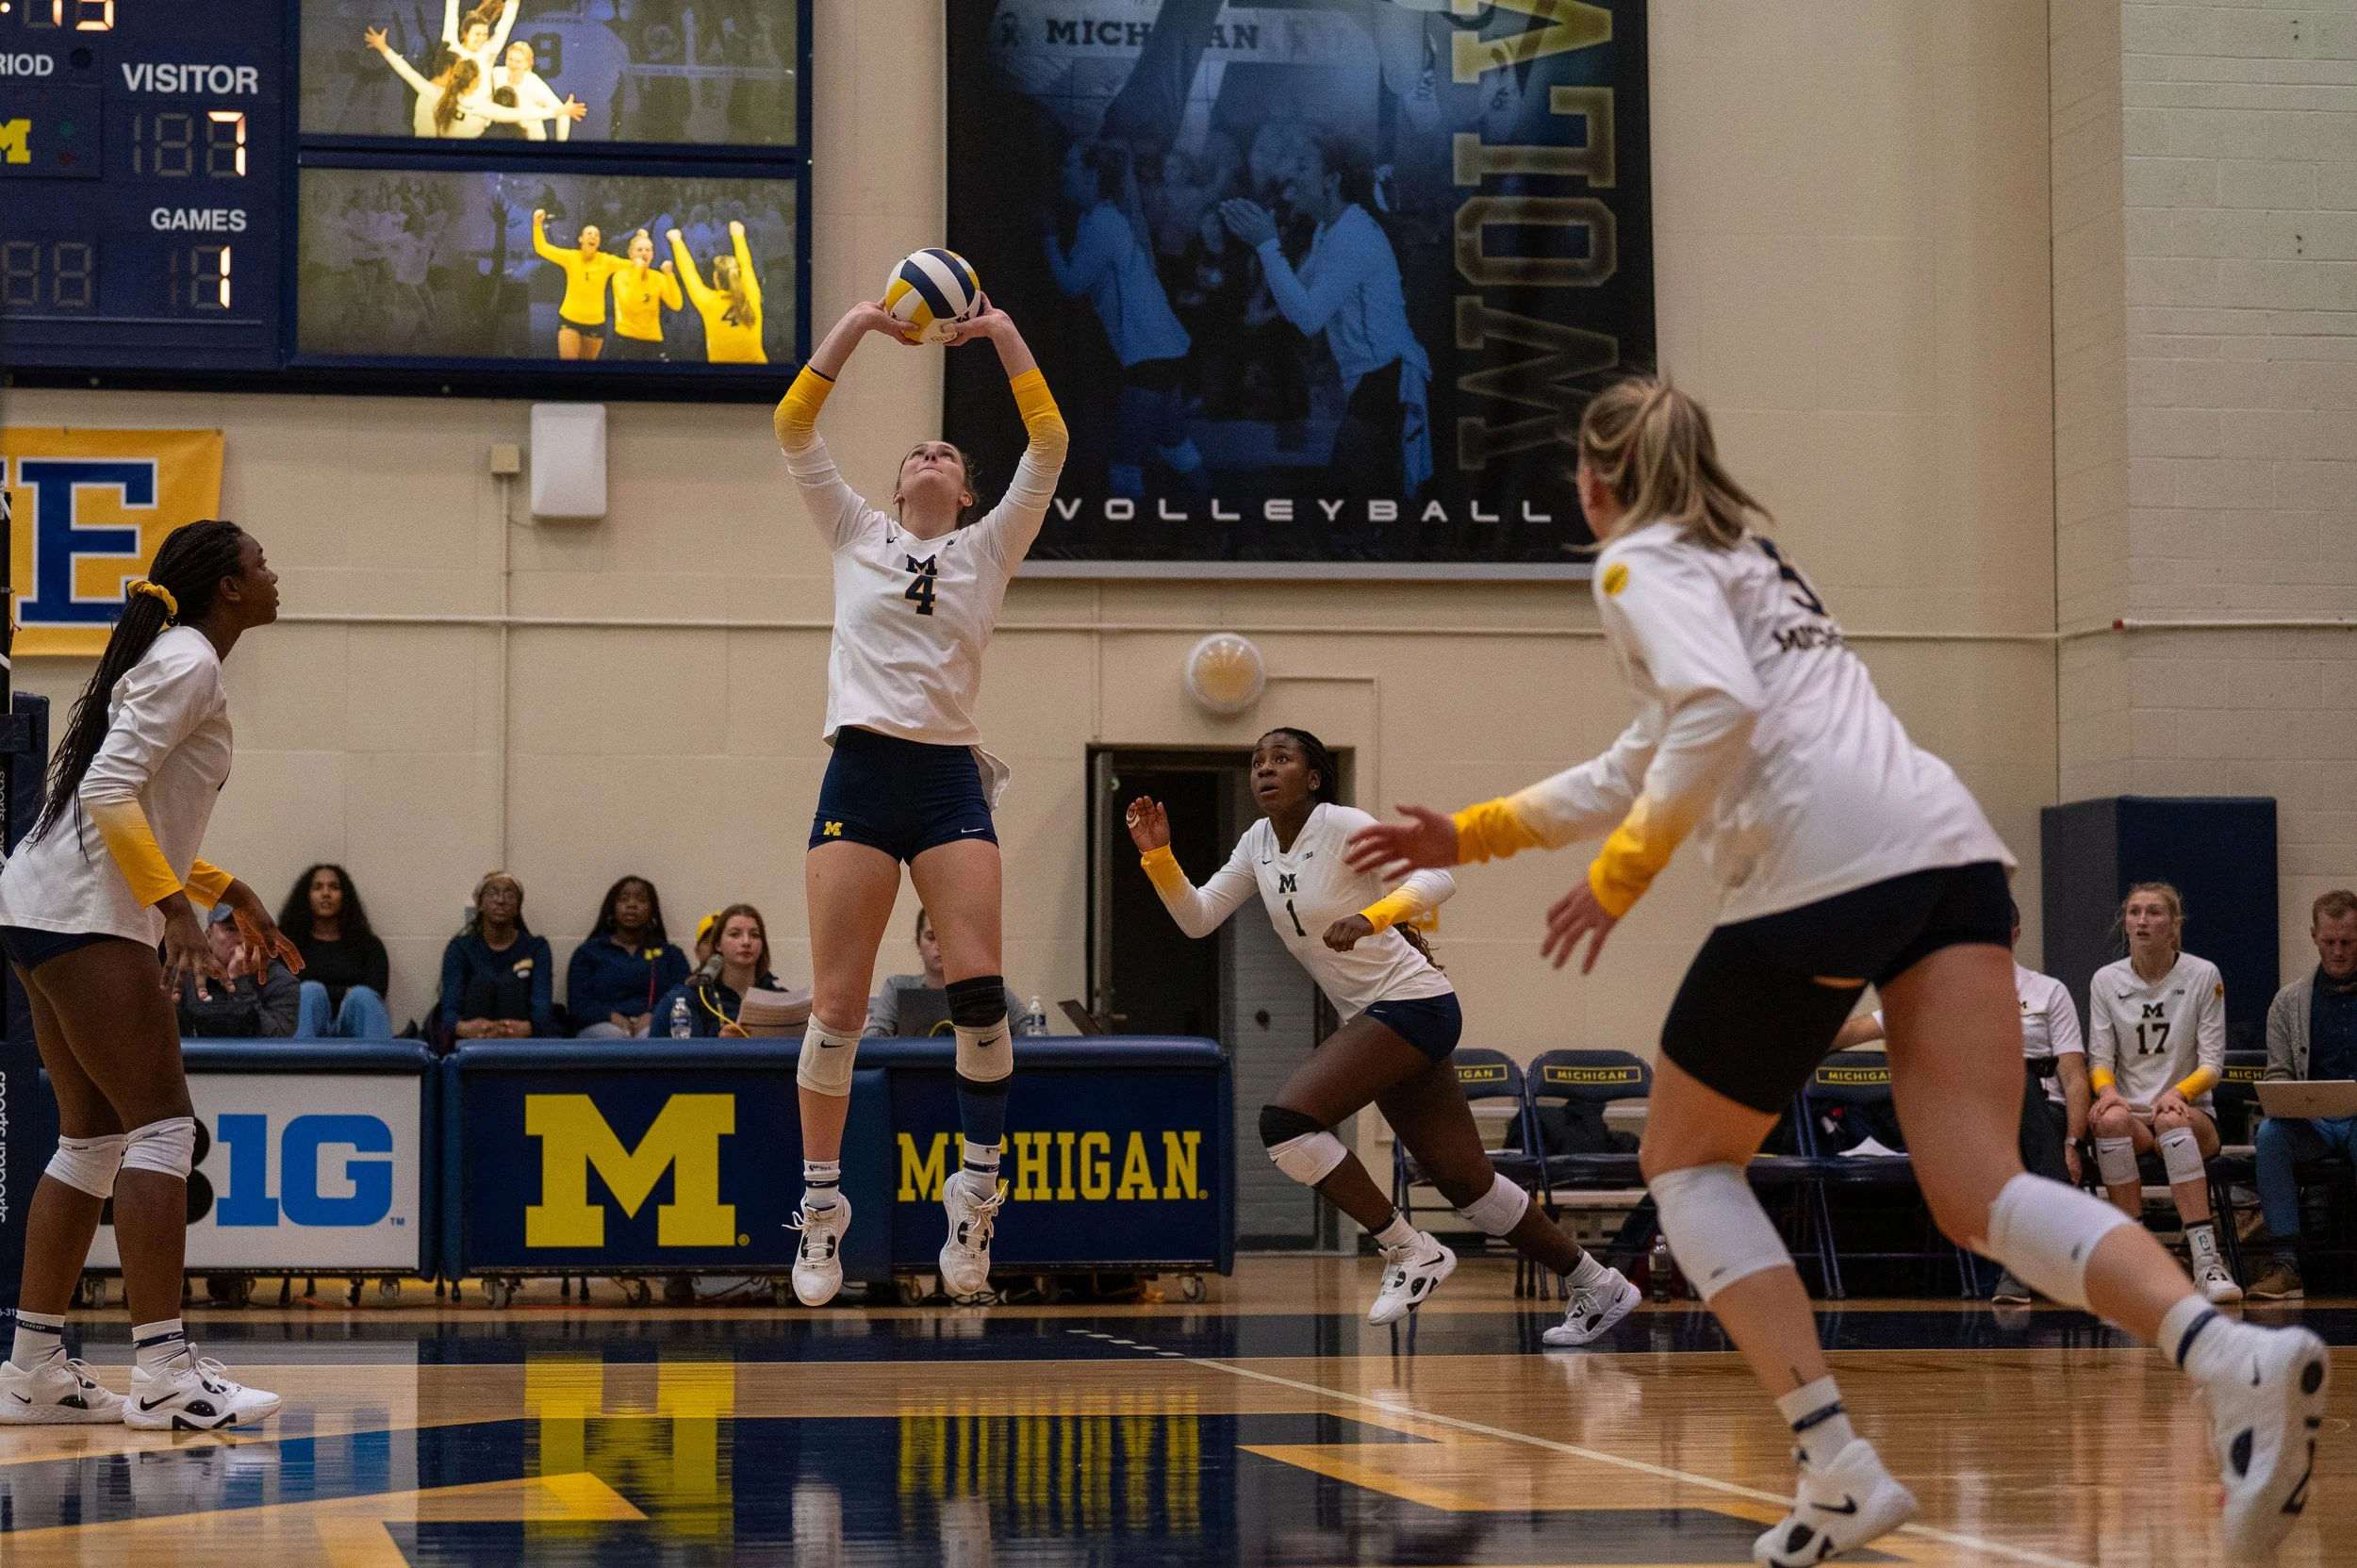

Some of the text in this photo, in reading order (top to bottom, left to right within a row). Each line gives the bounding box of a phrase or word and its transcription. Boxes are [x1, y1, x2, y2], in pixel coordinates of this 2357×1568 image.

[1046, 19, 1259, 48] MICHAN
[122, 63, 258, 94] VISITOR
[206, 110, 247, 177] 7
[150, 207, 247, 232] GAMES
[219, 245, 231, 309] 1
[1055, 498, 1552, 522] VOLLEYBALL
[905, 553, 938, 576] M
[904, 574, 937, 617] 4
[823, 821, 843, 836] M
[1278, 873, 1298, 894] M
[1286, 899, 1308, 936] 1
[2141, 1002, 2165, 1018] M
[2135, 1023, 2170, 1054] 17
[1557, 1070, 1627, 1080] MICHIGAN
[2228, 1069, 2263, 1080] MICH
[525, 1094, 735, 1247] M
[897, 1131, 1202, 1201] MHIGAN
